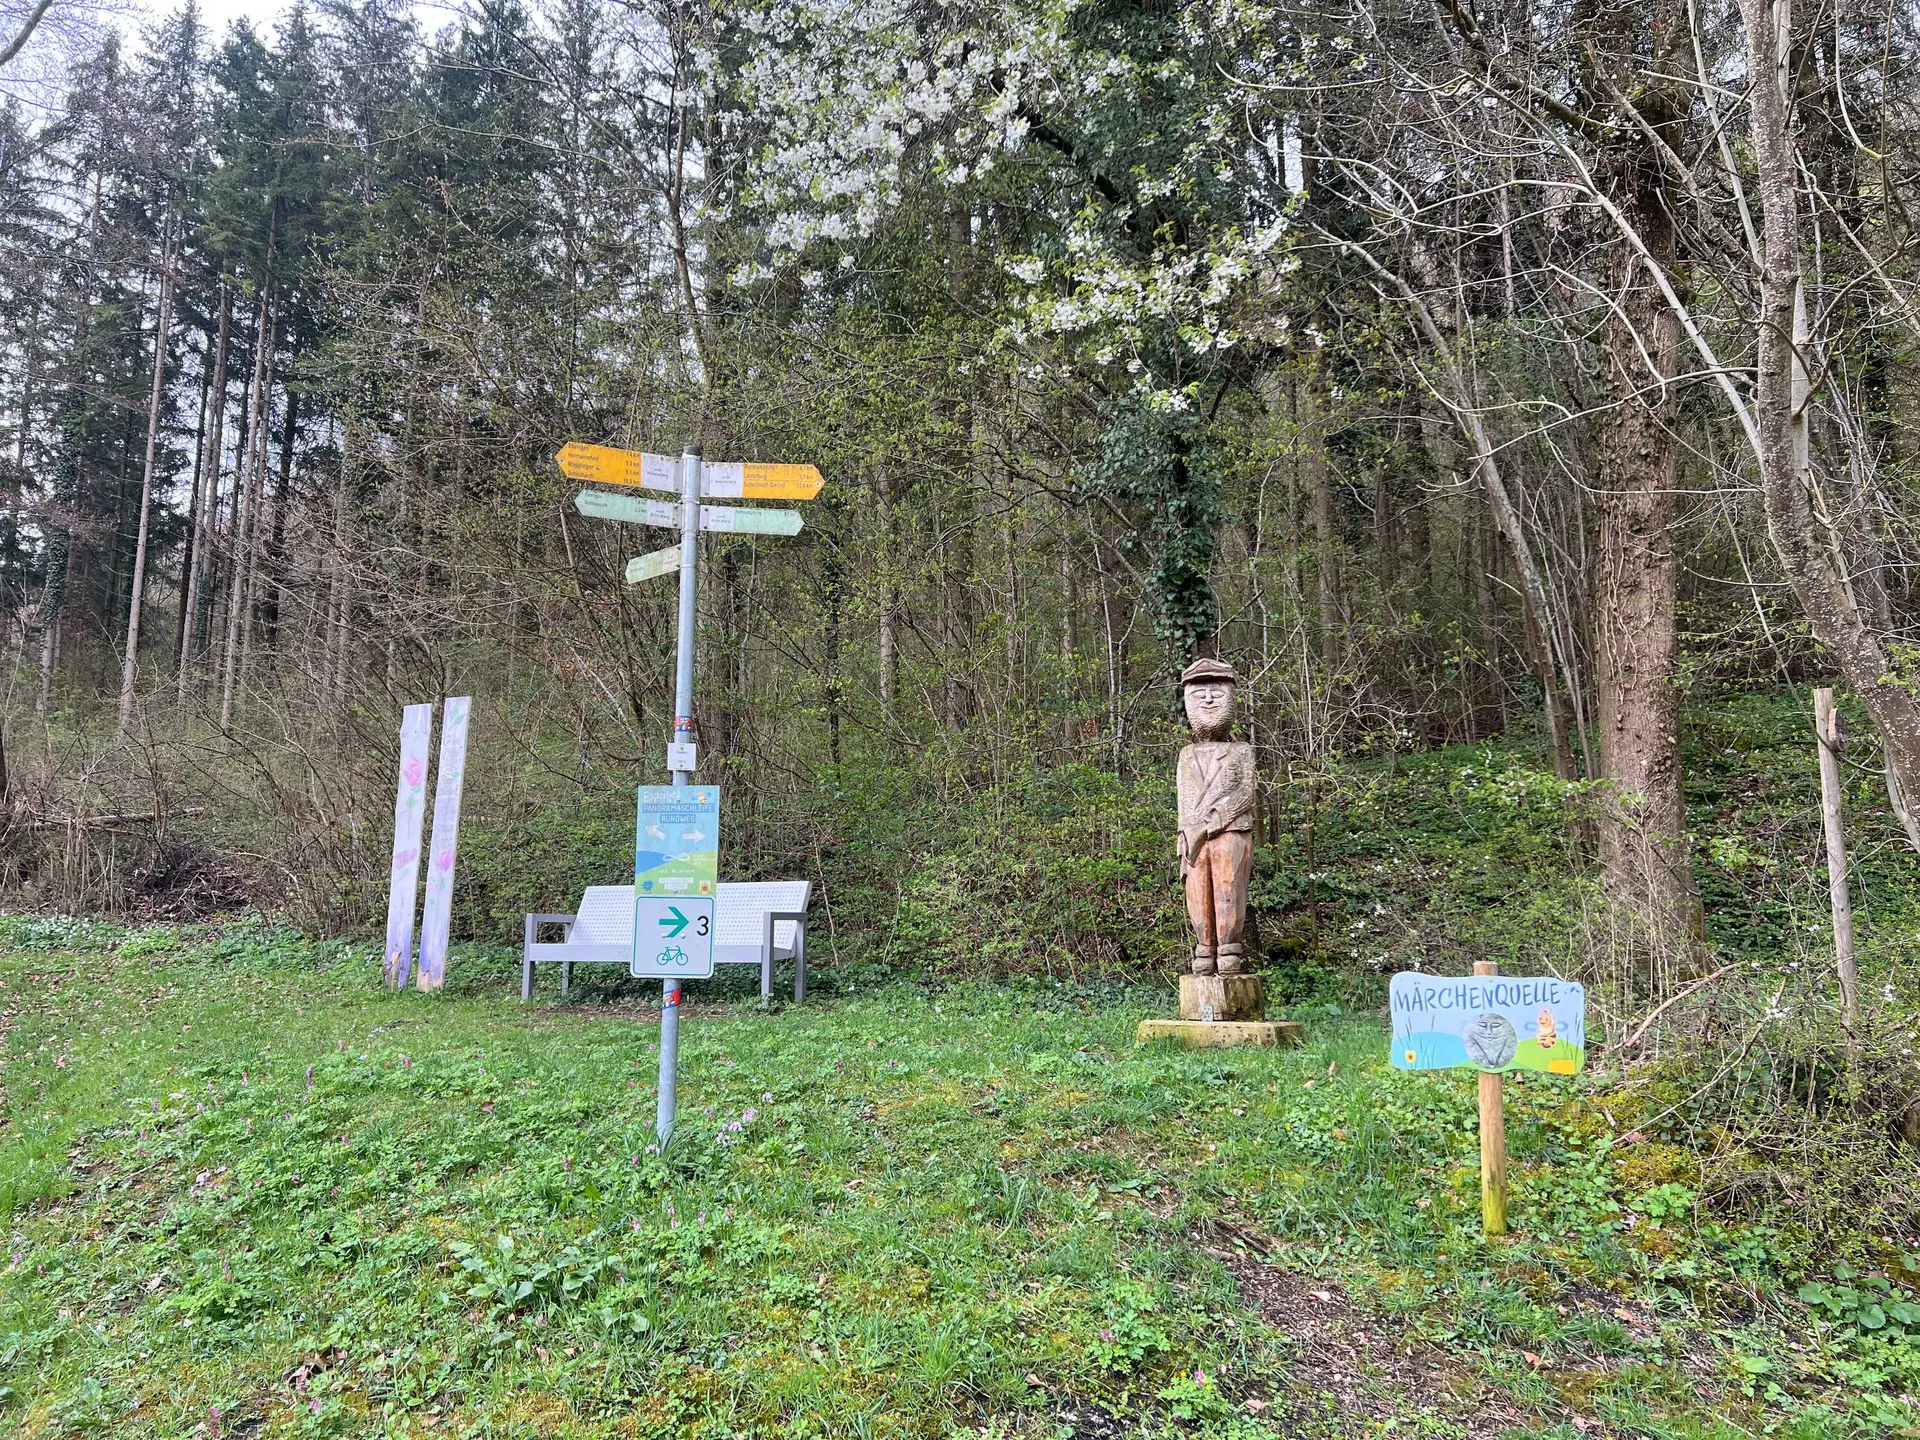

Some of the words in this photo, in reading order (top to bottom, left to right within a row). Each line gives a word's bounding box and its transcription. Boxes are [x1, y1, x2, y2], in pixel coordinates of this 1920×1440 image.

[643, 804, 713, 813] PANORAMASCHLEIFE
[660, 814, 696, 824] RUNDWEG
[696, 915, 710, 937] 3
[1394, 981, 1561, 1013] MÄRCHENQUELLE
